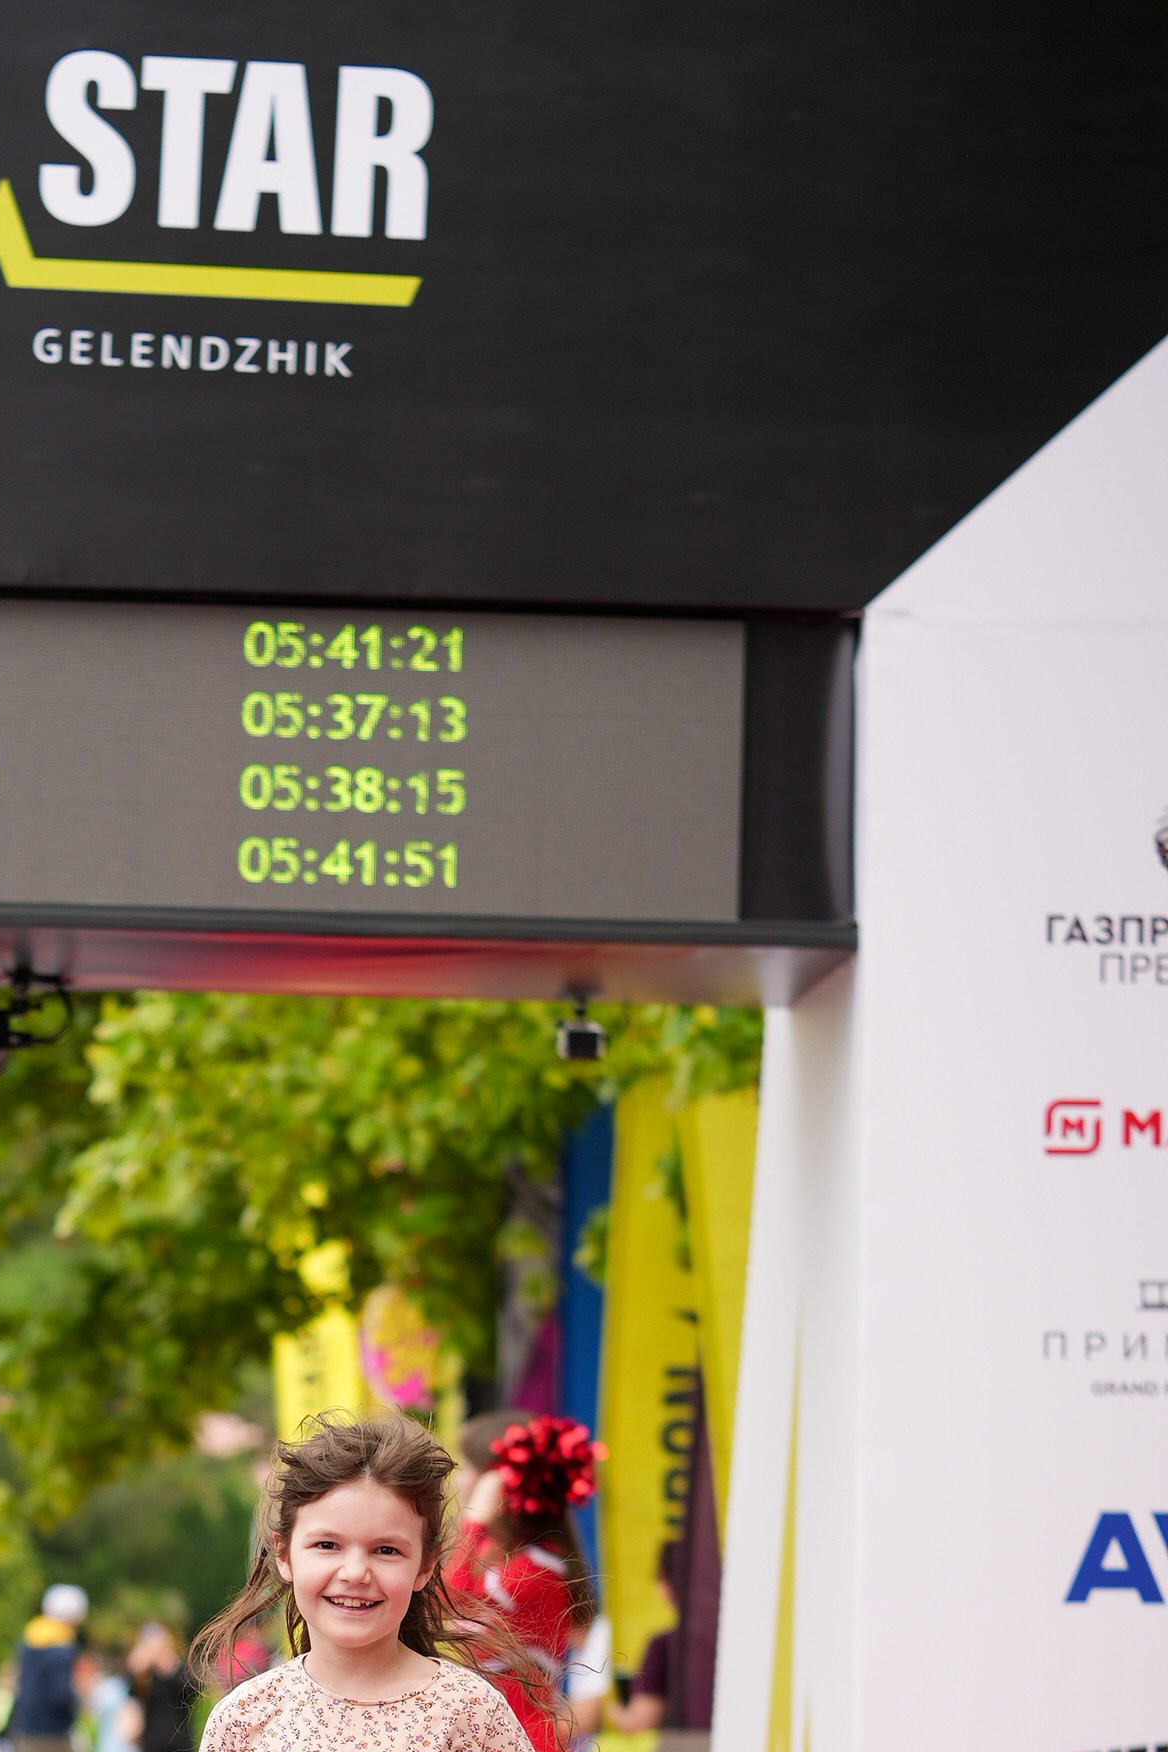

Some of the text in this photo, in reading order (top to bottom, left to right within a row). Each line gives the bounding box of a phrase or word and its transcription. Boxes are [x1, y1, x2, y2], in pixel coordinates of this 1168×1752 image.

[39, 49, 434, 241] STAR
[33, 328, 353, 378] GELENDZHIK
[243, 620, 464, 672] 05:41:21
[241, 690, 468, 742] 05:37:13
[239, 763, 467, 815] 05:38:15
[237, 836, 459, 888] 05:41:51
[1042, 1330, 1168, 1361] ПРИ
